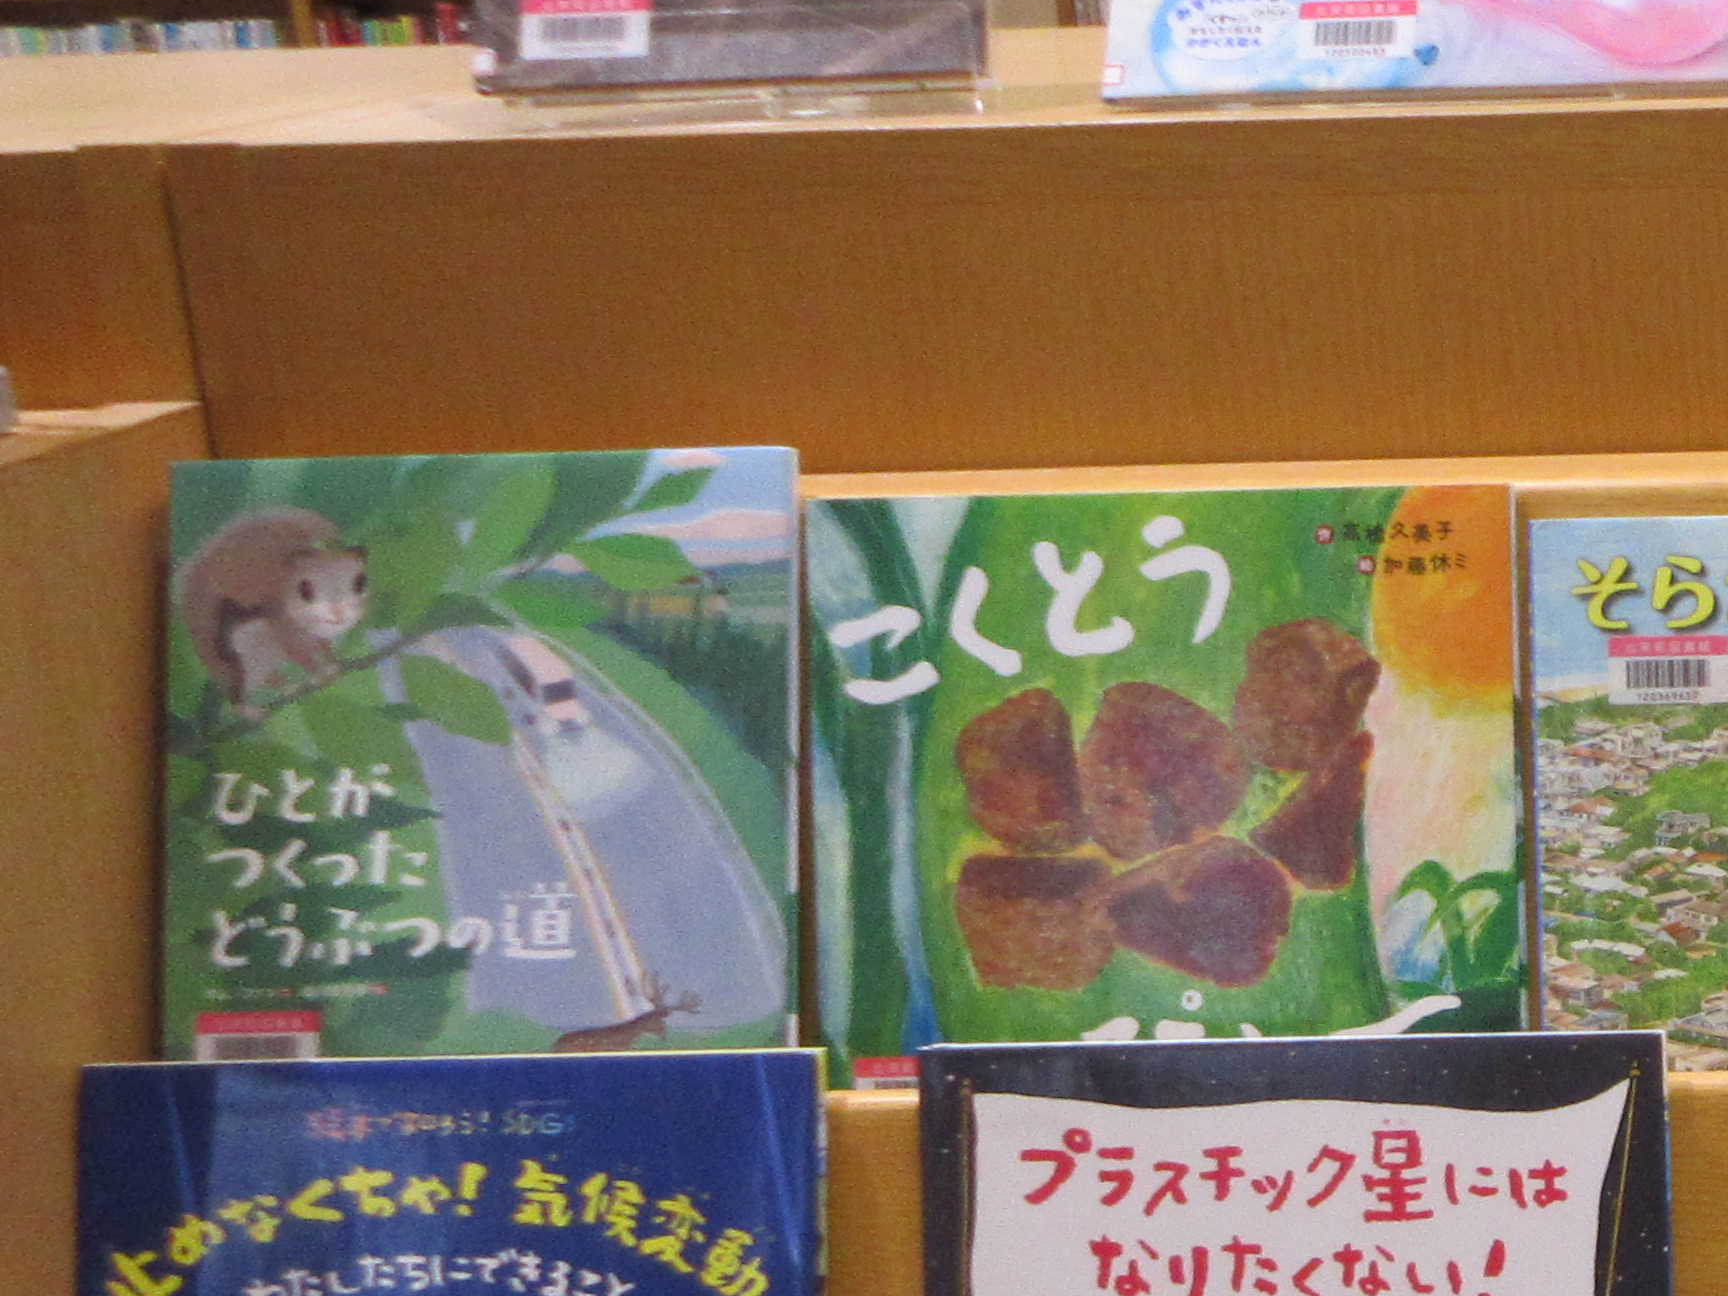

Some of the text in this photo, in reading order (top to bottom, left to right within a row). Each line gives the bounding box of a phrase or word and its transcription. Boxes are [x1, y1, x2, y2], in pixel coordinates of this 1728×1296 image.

[828, 515, 1232, 704] こくとう
[211, 763, 395, 825] ひとが
[206, 830, 428, 890] つくった
[211, 881, 578, 970] どうぶつの道
[1019, 1125, 1570, 1223] プラスチック星には
